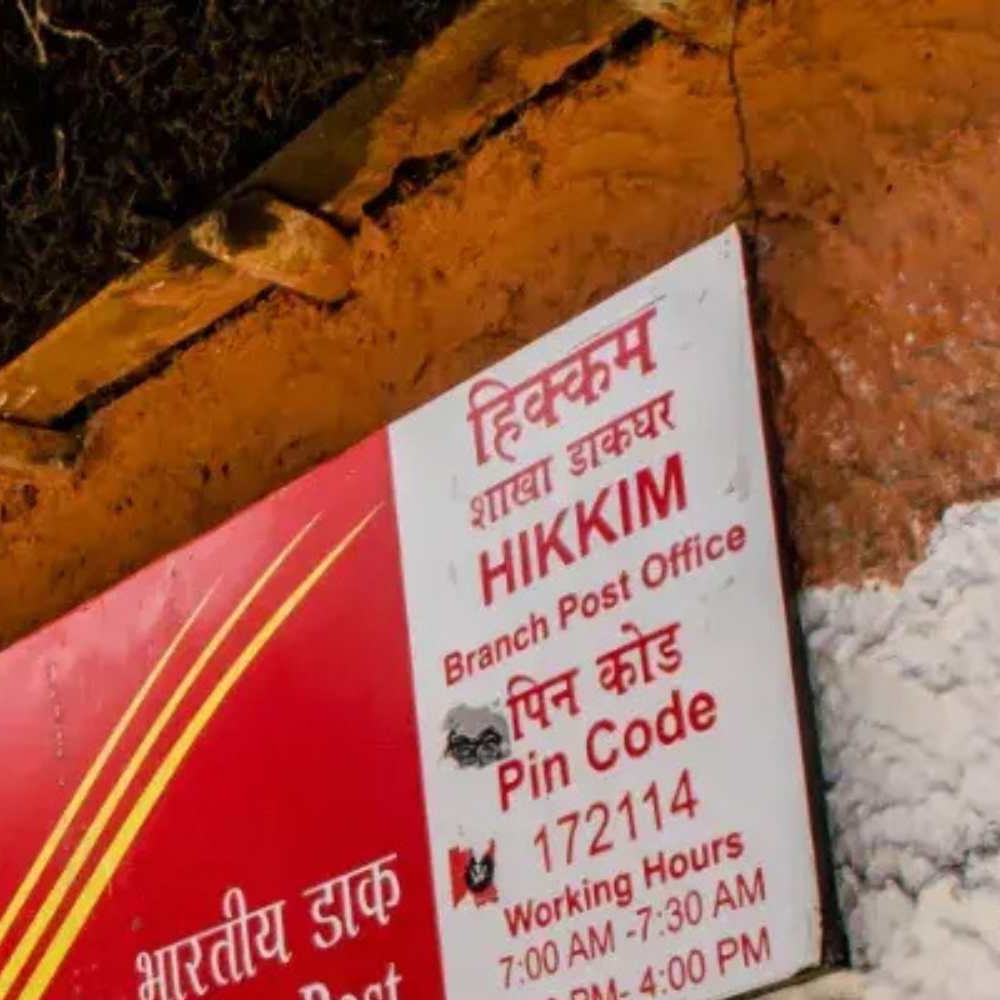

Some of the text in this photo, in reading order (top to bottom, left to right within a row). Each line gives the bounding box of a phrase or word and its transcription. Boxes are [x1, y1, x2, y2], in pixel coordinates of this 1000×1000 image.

[467, 306, 657, 464] हिक्कम
[470, 390, 676, 529] शाखा डाकघर
[478, 453, 687, 607] HIKKIM
[444, 523, 747, 686] Branch Post Office
[506, 622, 683, 740] पिन कोड
[498, 689, 718, 811] Pin Code
[534, 768, 700, 873] 172114
[302, 851, 401, 949] डाक
[499, 938, 560, 990] 7:00
[568, 920, 616, 967] AM
[713, 867, 766, 913] AM
[504, 831, 745, 937] Working Hours
[639, 949, 706, 998] 4:00
[717, 926, 772, 974] PM
